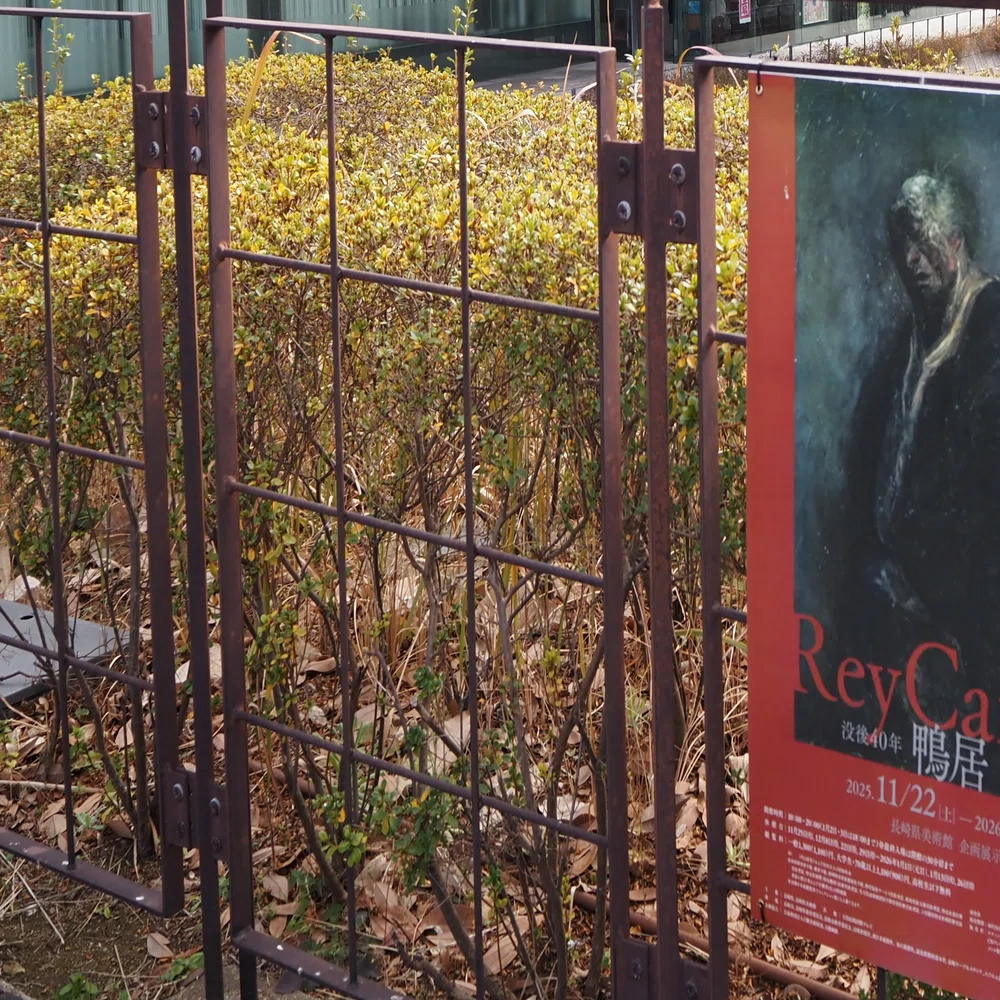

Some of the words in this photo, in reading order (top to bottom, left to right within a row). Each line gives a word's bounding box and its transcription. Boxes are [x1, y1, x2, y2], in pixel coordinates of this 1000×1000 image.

[841, 719, 903, 754] 没後40年
[912, 721, 988, 793] 鴨居
[890, 818, 954, 850] 長崎県美術館
